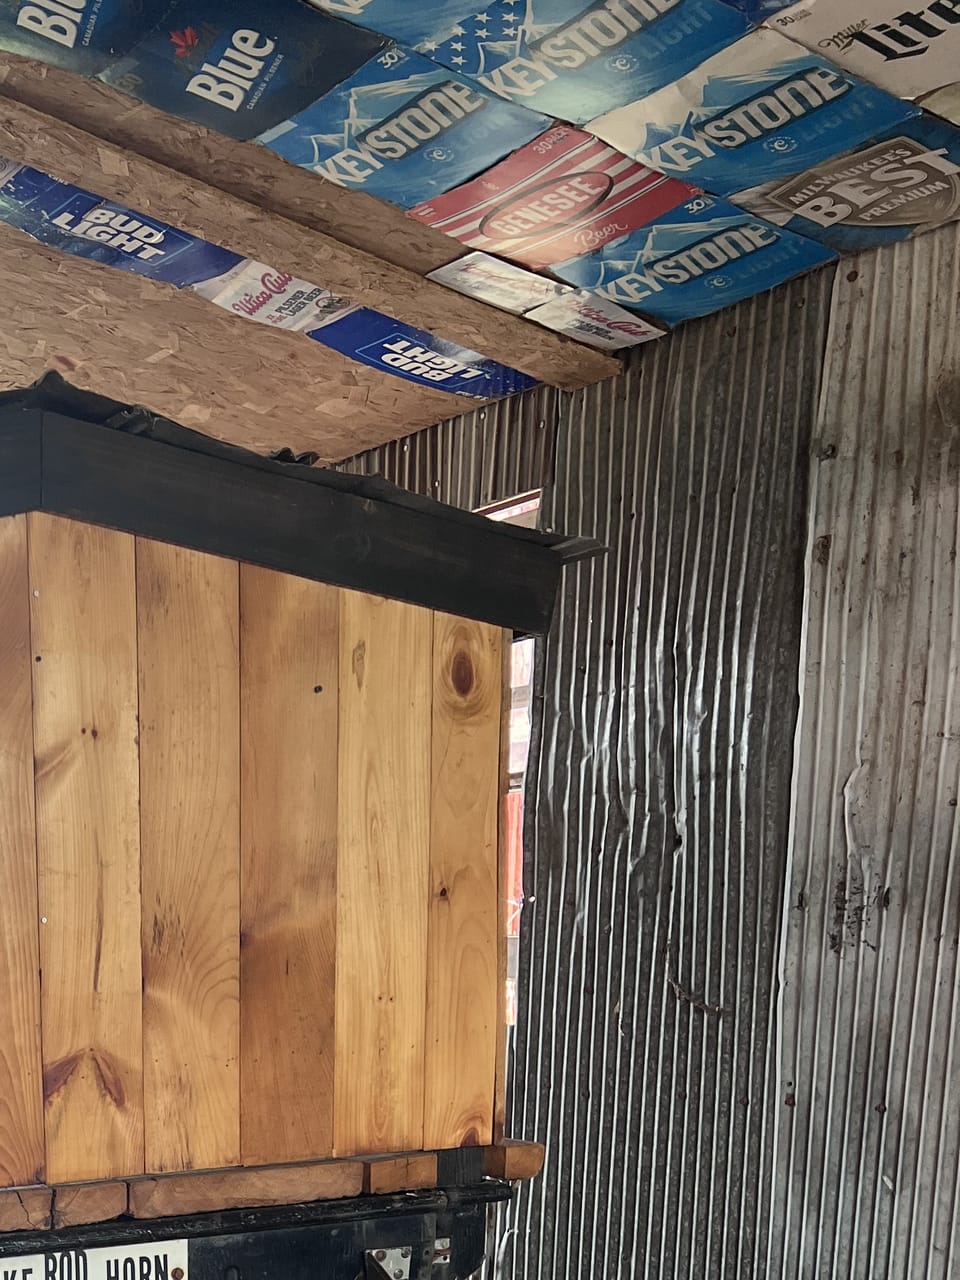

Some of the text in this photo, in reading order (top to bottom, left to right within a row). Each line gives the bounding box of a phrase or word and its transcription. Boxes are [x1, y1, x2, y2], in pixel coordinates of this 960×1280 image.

[776, 15, 796, 26] 30
[818, 18, 871, 50] Miller
[186, 28, 275, 112] Blue
[377, 51, 399, 69] 30
[247, 54, 285, 110] CANADIAN PILSENER
[314, 81, 485, 187] KEYSTONE
[636, 68, 852, 174] KEYSTONE
[790, 148, 912, 205] MILWAUKEE'S
[793, 148, 960, 228] BEST
[490, 177, 606, 237] GENESEE
[684, 199, 705, 213] 30
[859, 181, 950, 221] PREMIUM
[51, 212, 166, 260] LIGHT
[83, 208, 165, 244] BUD
[573, 221, 629, 248] Beer
[594, 223, 781, 303] KEYSTONE
[232, 291, 273, 315] Utica
[261, 272, 293, 295] Club
[275, 290, 307, 313] PILSENER
[381, 353, 453, 382] BUD
[383, 339, 484, 379] LIGHT
